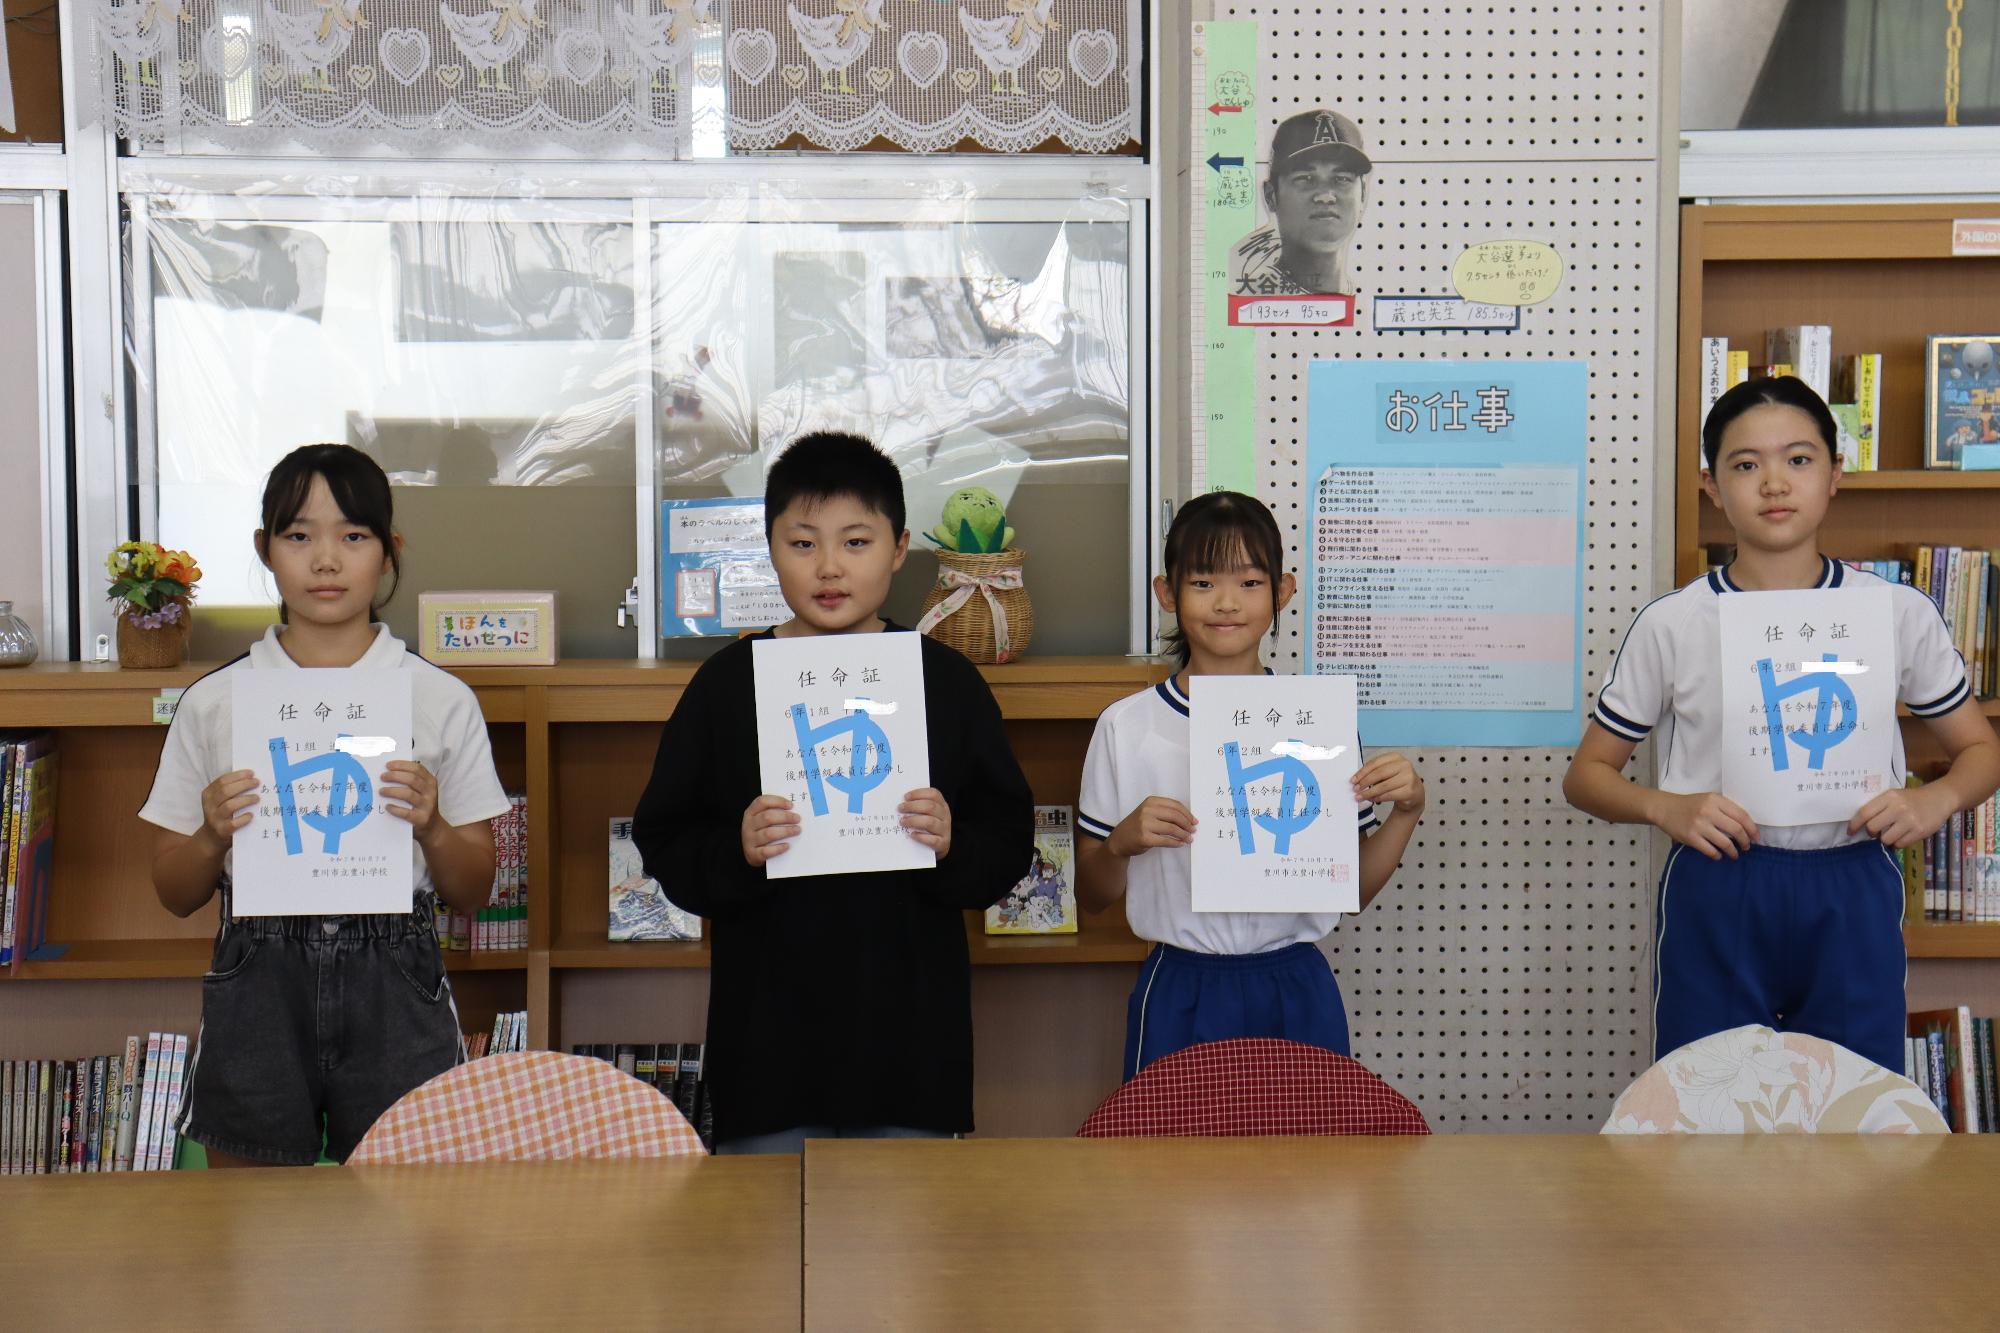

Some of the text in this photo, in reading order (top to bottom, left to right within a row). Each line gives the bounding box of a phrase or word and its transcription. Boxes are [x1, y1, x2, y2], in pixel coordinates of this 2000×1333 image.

[1213, 127, 1226, 135] 190
[1312, 111, 1338, 144] A
[1213, 199, 1227, 207] 180
[1959, 231, 2000, 244] 外国の
[1212, 271, 1226, 279] 170
[1212, 342, 1225, 350] 160
[1385, 385, 1515, 434] お仕事
[1211, 413, 1224, 421] 150
[681, 518, 758, 529] 本のラベルのしくみ
[444, 630, 530, 648] たいせつに
[1764, 622, 1851, 643] 任命証
[1750, 662, 1797, 674] 6年2組
[797, 666, 881, 688] 任命証
[277, 701, 368, 722] 任命証
[784, 706, 830, 719] 6年1組
[1749, 701, 1853, 714] あなたを令和7年度
[1231, 707, 1315, 728] 任命証
[1749, 720, 1870, 737] 後期学級委員に任命し
[268, 741, 317, 753] 6年1組
[785, 742, 888, 759] あなたを令和7年度
[1217, 746, 1262, 757] 6年2組
[785, 763, 904, 781] 後期学級委員に任命し
[260, 782, 369, 795] あなたを令和7年度
[1215, 785, 1317, 797] あなたを令和7年度
[259, 805, 386, 817] 後期学級委員に任命し
[1215, 807, 1333, 818] 後期学級委員に任命し
[499, 813, 509, 869] ちがいえさがし
